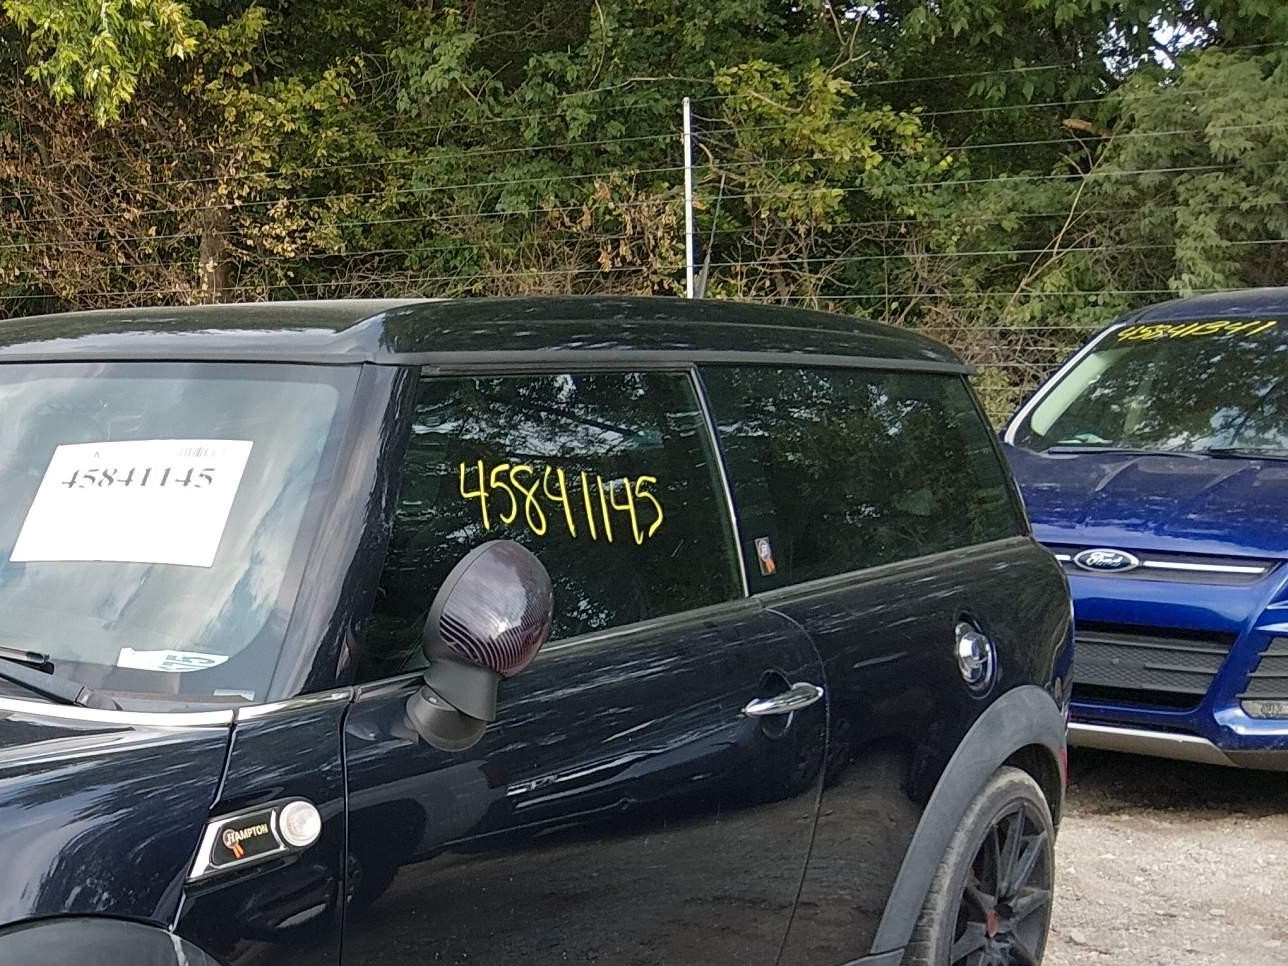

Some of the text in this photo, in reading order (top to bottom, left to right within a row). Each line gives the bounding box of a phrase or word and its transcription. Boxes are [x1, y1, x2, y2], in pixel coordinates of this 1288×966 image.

[62, 465, 217, 489] 45841145
[458, 459, 665, 545] 45841145
[226, 823, 269, 845] HAMPTON
